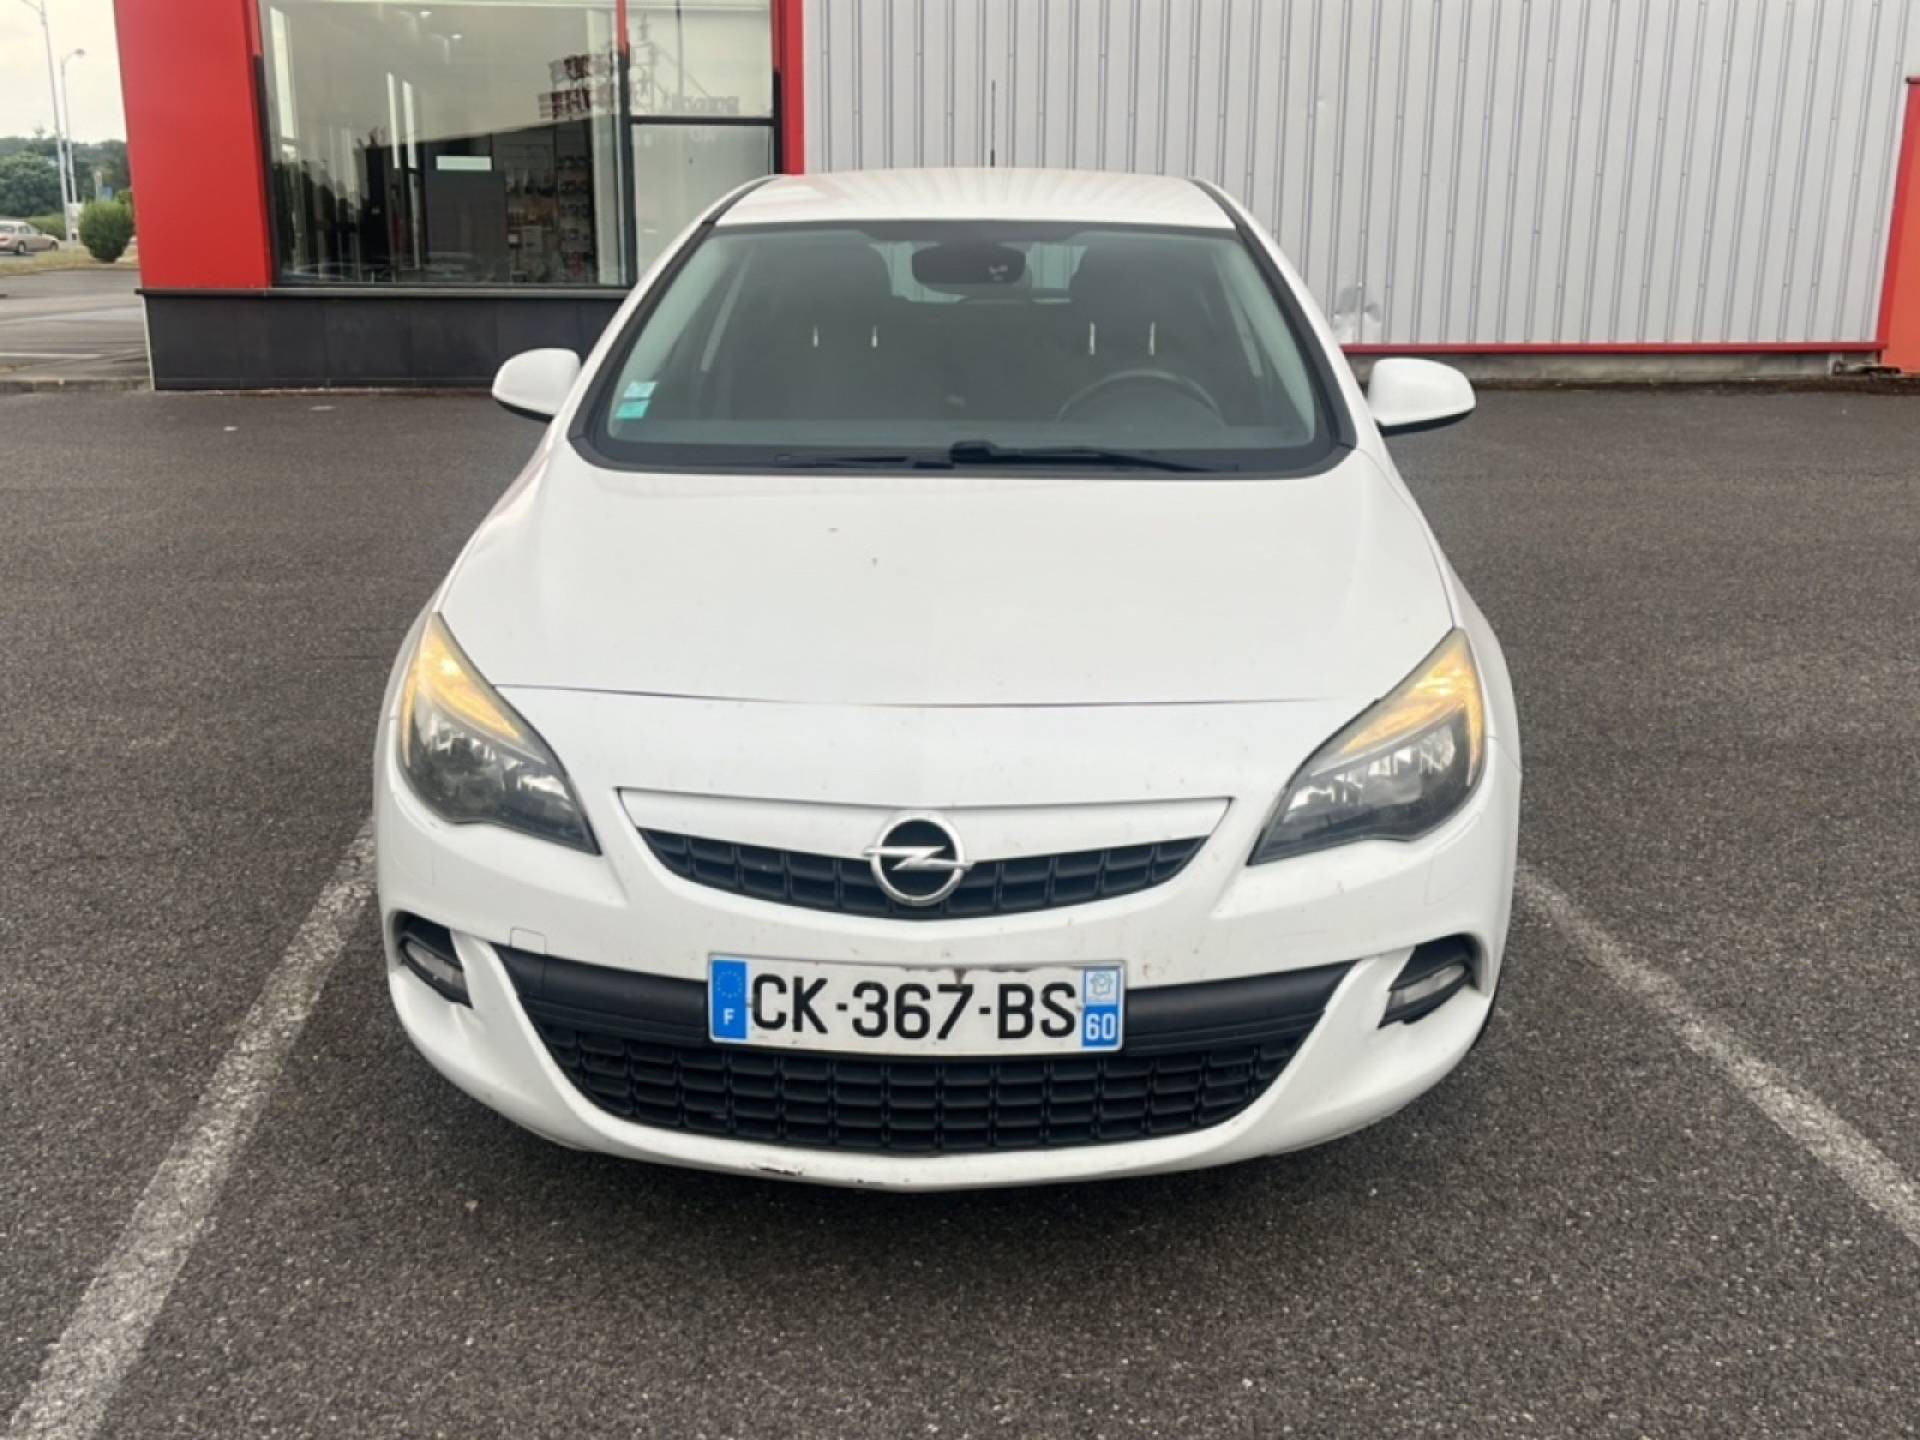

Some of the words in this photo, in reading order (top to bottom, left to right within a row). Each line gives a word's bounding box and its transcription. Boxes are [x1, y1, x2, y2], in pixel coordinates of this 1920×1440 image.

[723, 1007, 735, 1026] F
[752, 973, 1076, 1040] CK-367-BS
[1085, 1013, 1116, 1040] 60
